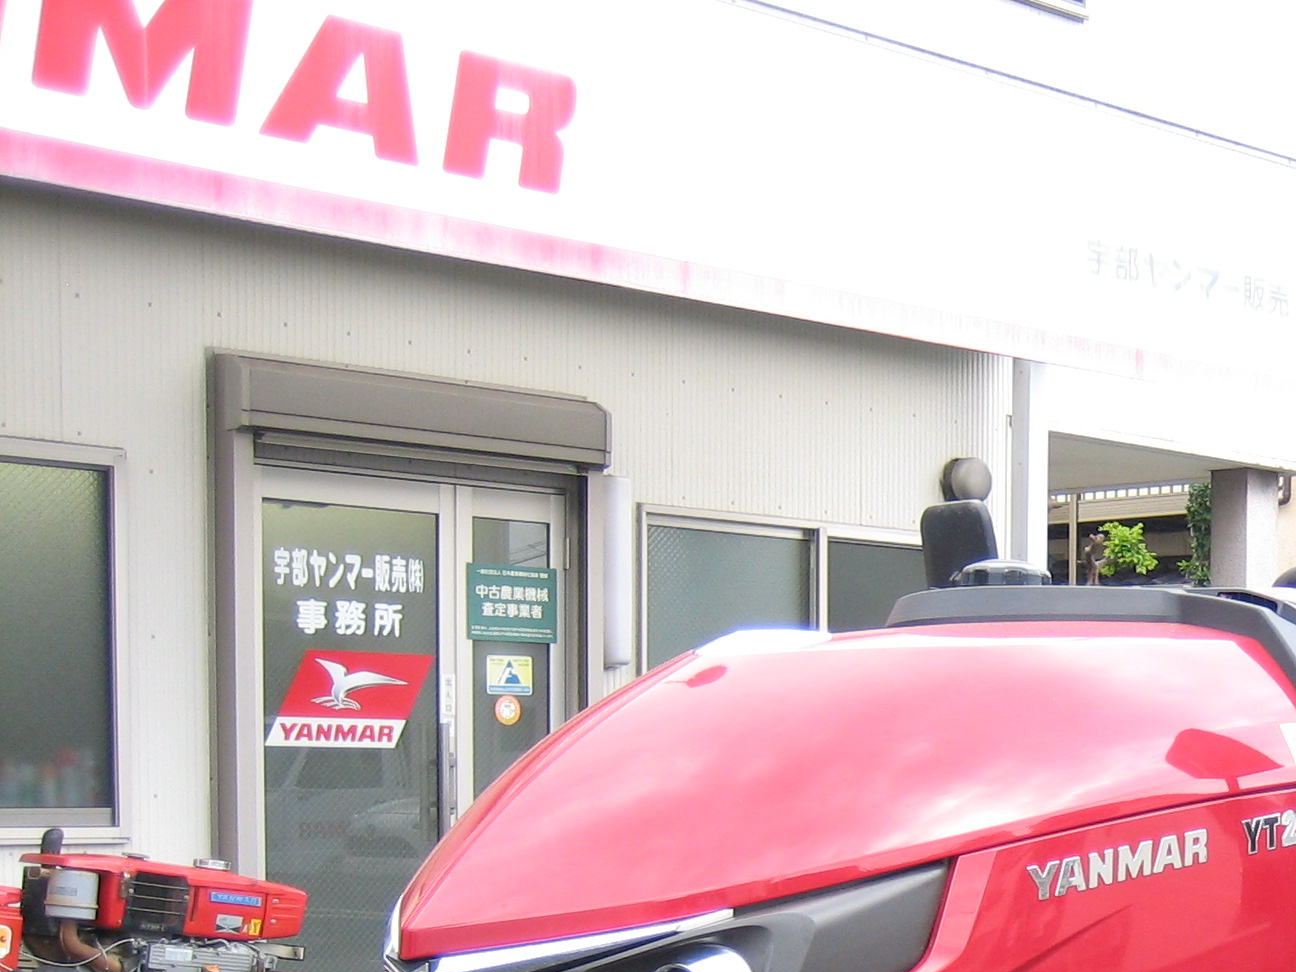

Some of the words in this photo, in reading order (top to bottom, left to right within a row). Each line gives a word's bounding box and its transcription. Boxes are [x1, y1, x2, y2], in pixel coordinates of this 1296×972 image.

[0, 0, 577, 194] MAR
[296, 599, 403, 638] 事務所
[279, 722, 395, 743] YANMAR
[1026, 828, 1208, 901] YANMAR
